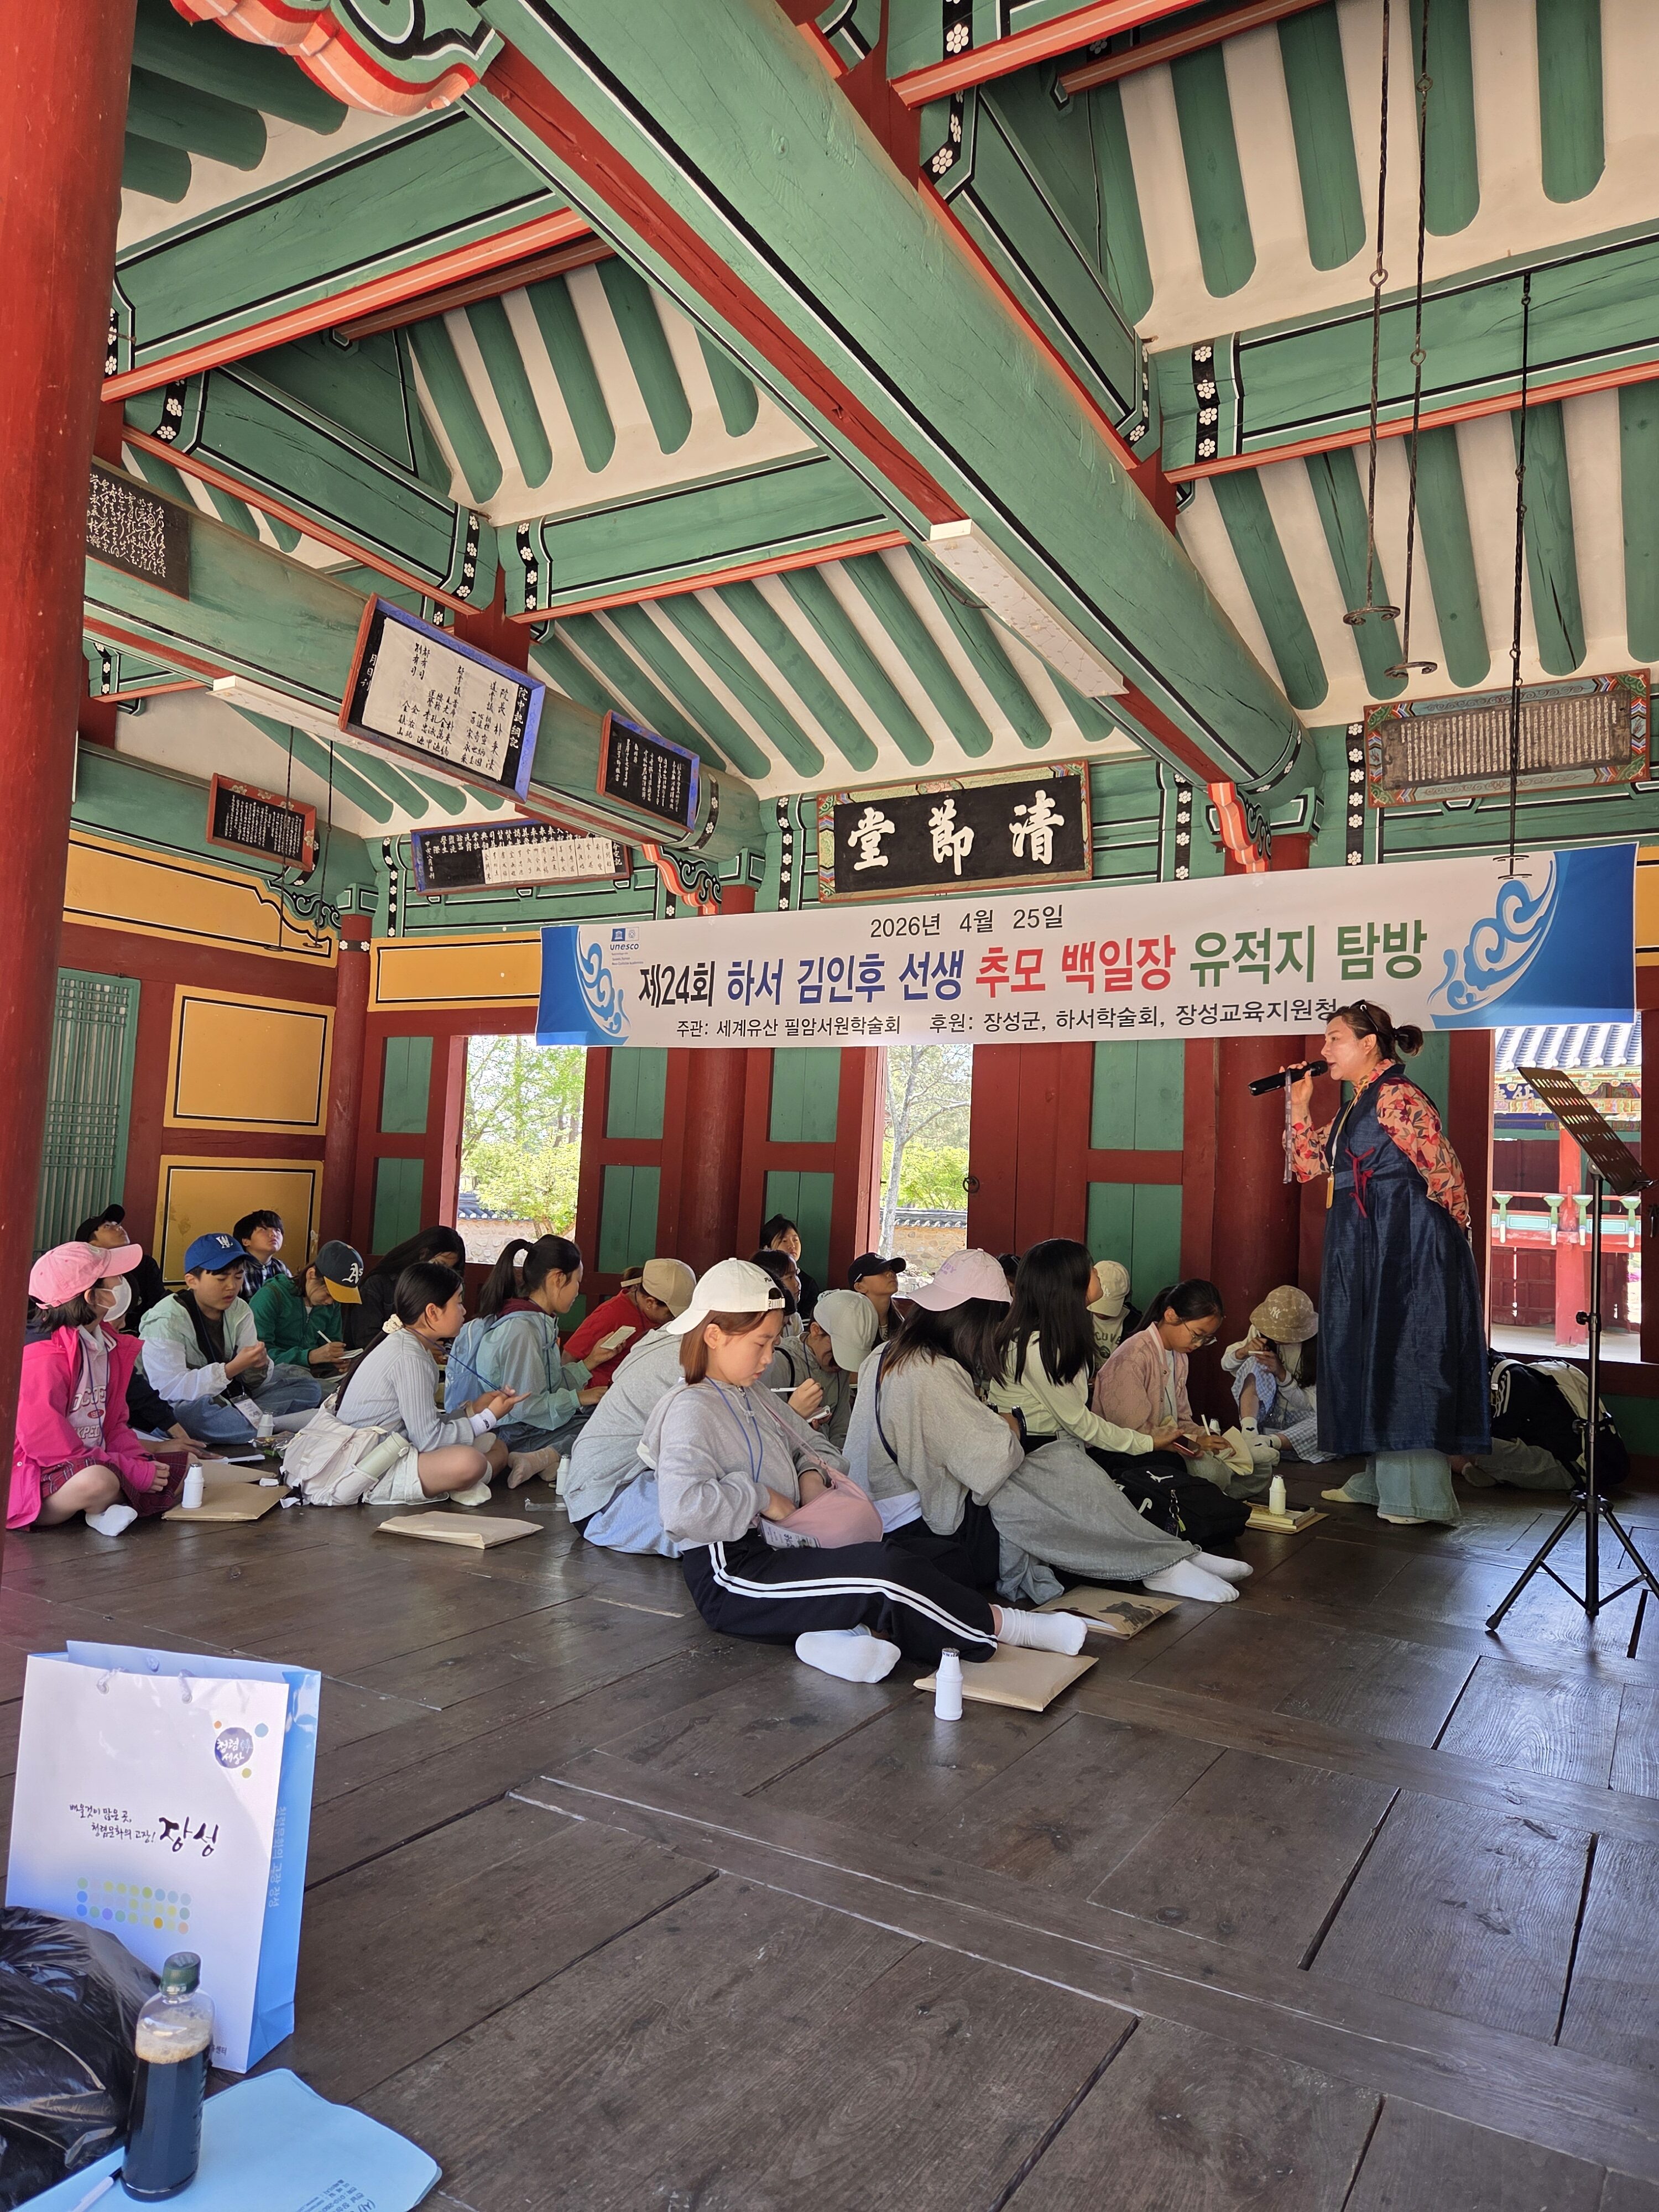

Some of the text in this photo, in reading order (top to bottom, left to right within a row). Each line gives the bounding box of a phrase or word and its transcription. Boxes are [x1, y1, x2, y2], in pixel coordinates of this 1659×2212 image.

[871, 905, 1062, 937] 2026년 4월 25일
[639, 920, 1427, 1008] 제24회 하서 김인후 선생 추모 백일장 유적지 탐방
[677, 998, 1337, 1037] 주관: 세계유산 필암서원학술회 후원: 장성군, 하서학술회, 장성교육지원청
[1270, 1307, 1281, 1319] NY
[159, 1816, 219, 1857] 장성
